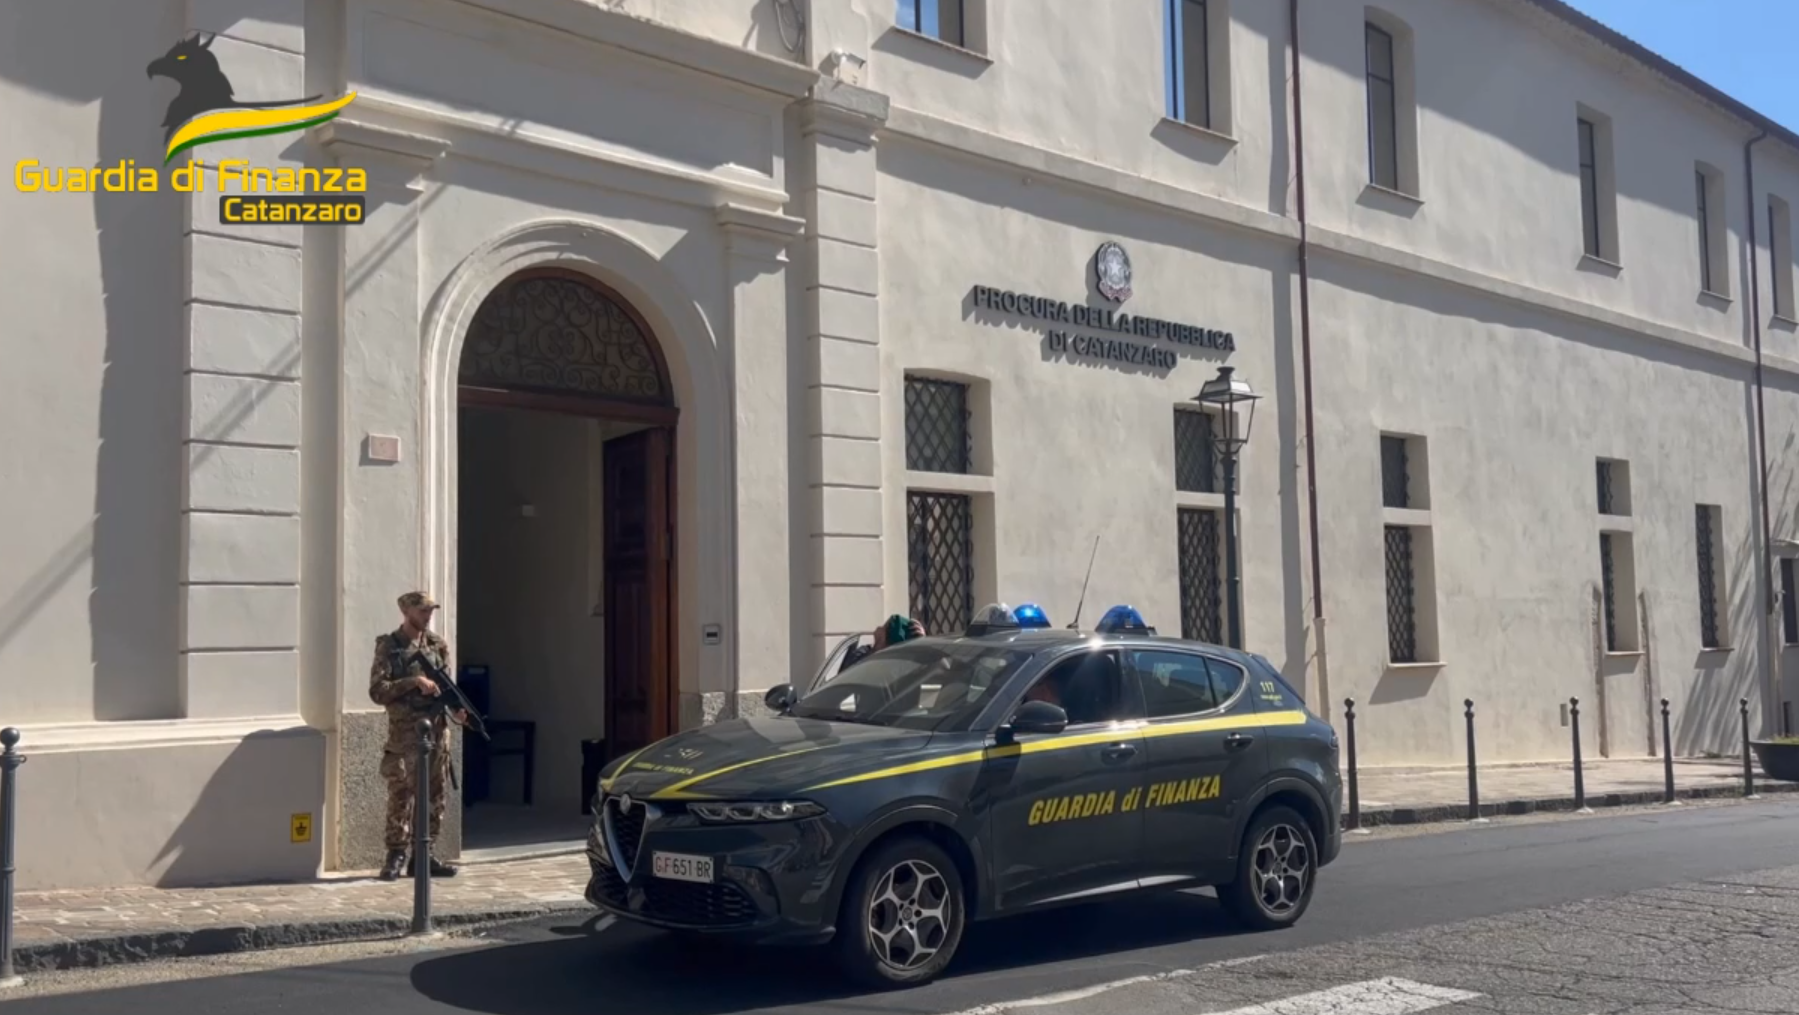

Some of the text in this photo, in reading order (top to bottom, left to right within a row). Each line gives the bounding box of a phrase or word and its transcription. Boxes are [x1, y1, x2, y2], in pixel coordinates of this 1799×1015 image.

[973, 285, 1236, 351] PROCURA DELLA REPUBBLICA
[1049, 330, 1177, 369] DI CATANZARO
[1028, 774, 1221, 826] GUARDIA di FINANZA
[673, 858, 692, 875] 651
[696, 861, 711, 878] BR
